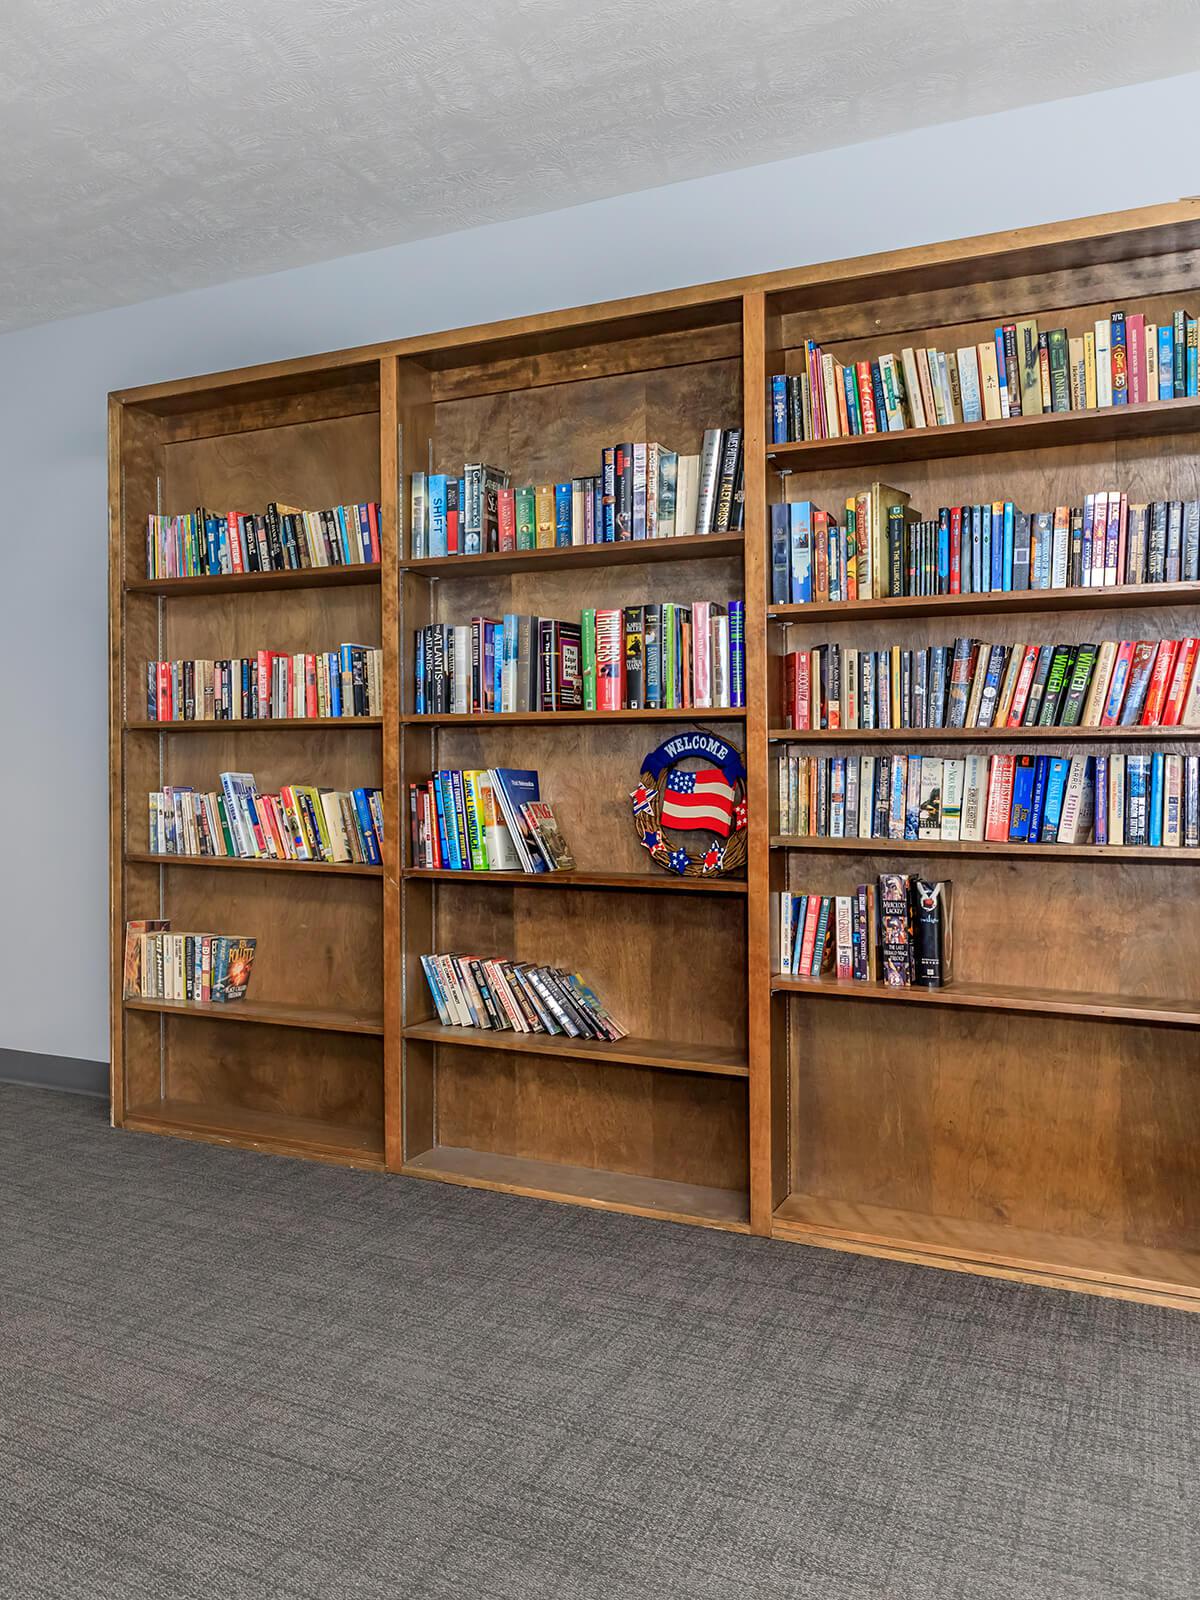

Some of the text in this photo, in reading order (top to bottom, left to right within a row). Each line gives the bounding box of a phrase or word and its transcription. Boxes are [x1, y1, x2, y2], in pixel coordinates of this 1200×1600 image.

[724, 432, 739, 474] JAMES PATTERSON
[720, 483, 732, 501] ALEX
[433, 498, 442, 533] SHIFT
[718, 503, 730, 525] CROSS
[597, 611, 620, 662] THRILLERS
[731, 611, 742, 643] PASTIME
[434, 633, 443, 679] ATLANTIS
[495, 635, 503, 667] KOONTZ
[799, 672, 808, 700] KOONTZ
[1048, 655, 1069, 692] WICKED
[1072, 653, 1093, 691] WICKED
[664, 735, 728, 760] WELCOME
[1000, 767, 1012, 824] THE HISTORY OF
[1048, 778, 1061, 816] FINAL KILL
[1063, 762, 1080, 830] HARRIS Archangel
[465, 779, 479, 850] JANET EVANOVICH
[443, 968, 454, 989] COMPLETE
[451, 990, 459, 1004] ROBOT
